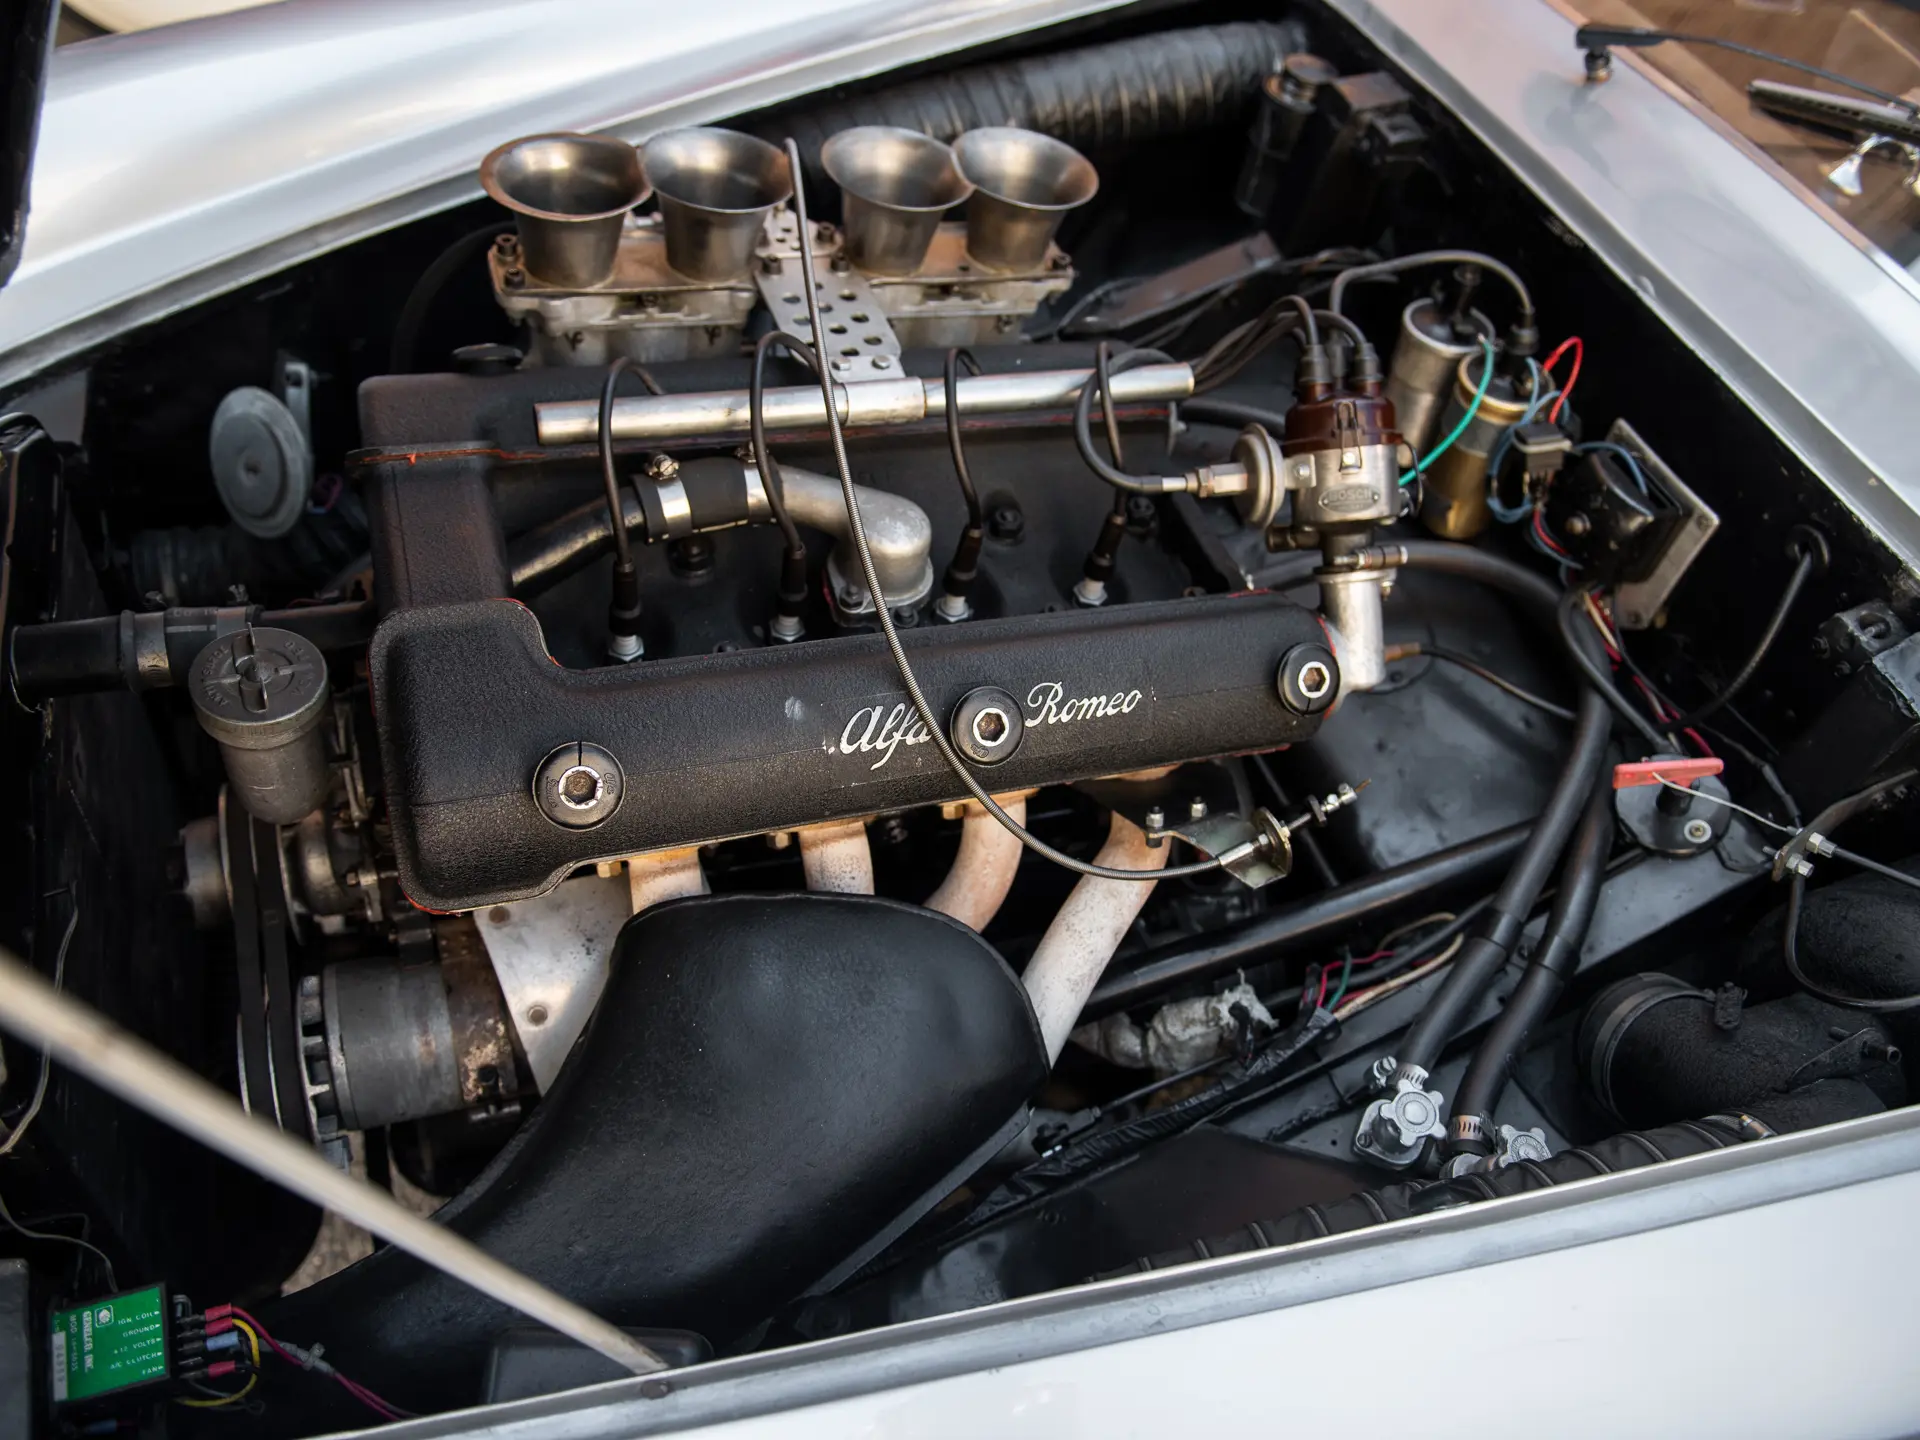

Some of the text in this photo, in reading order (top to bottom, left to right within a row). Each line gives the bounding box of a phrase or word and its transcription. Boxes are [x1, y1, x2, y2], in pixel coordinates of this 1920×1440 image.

[839, 681, 1143, 771] Alfa Romeo
[117, 1311, 153, 1325] IGN COIL
[122, 1325, 155, 1337] GROUND
[132, 1338, 156, 1350] VOLTS
[126, 1352, 158, 1365] CLUTCH
[141, 1366, 159, 1375] FAN
